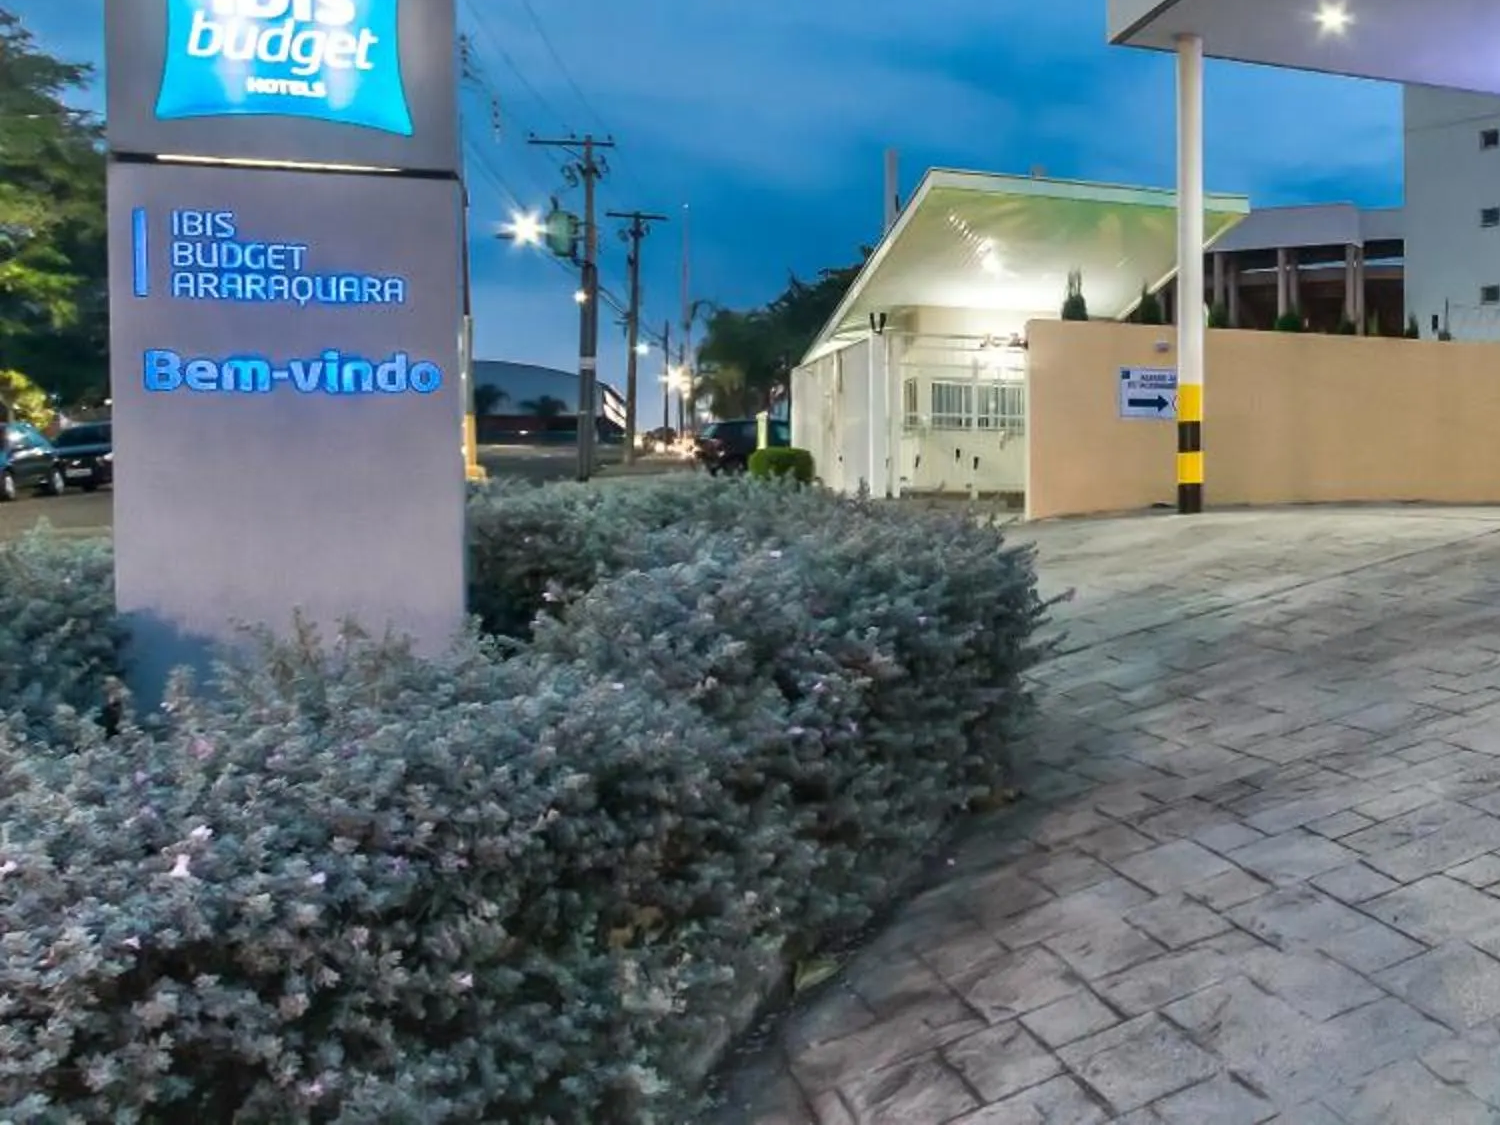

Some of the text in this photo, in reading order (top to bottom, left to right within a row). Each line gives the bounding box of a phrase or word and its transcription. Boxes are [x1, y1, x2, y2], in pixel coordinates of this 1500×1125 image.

[187, 10, 379, 76] budget
[172, 210, 236, 238] IBIS
[172, 241, 307, 270] BUDGET
[172, 272, 405, 305] ARARAQUARA
[144, 349, 442, 394] Bem-vindo
